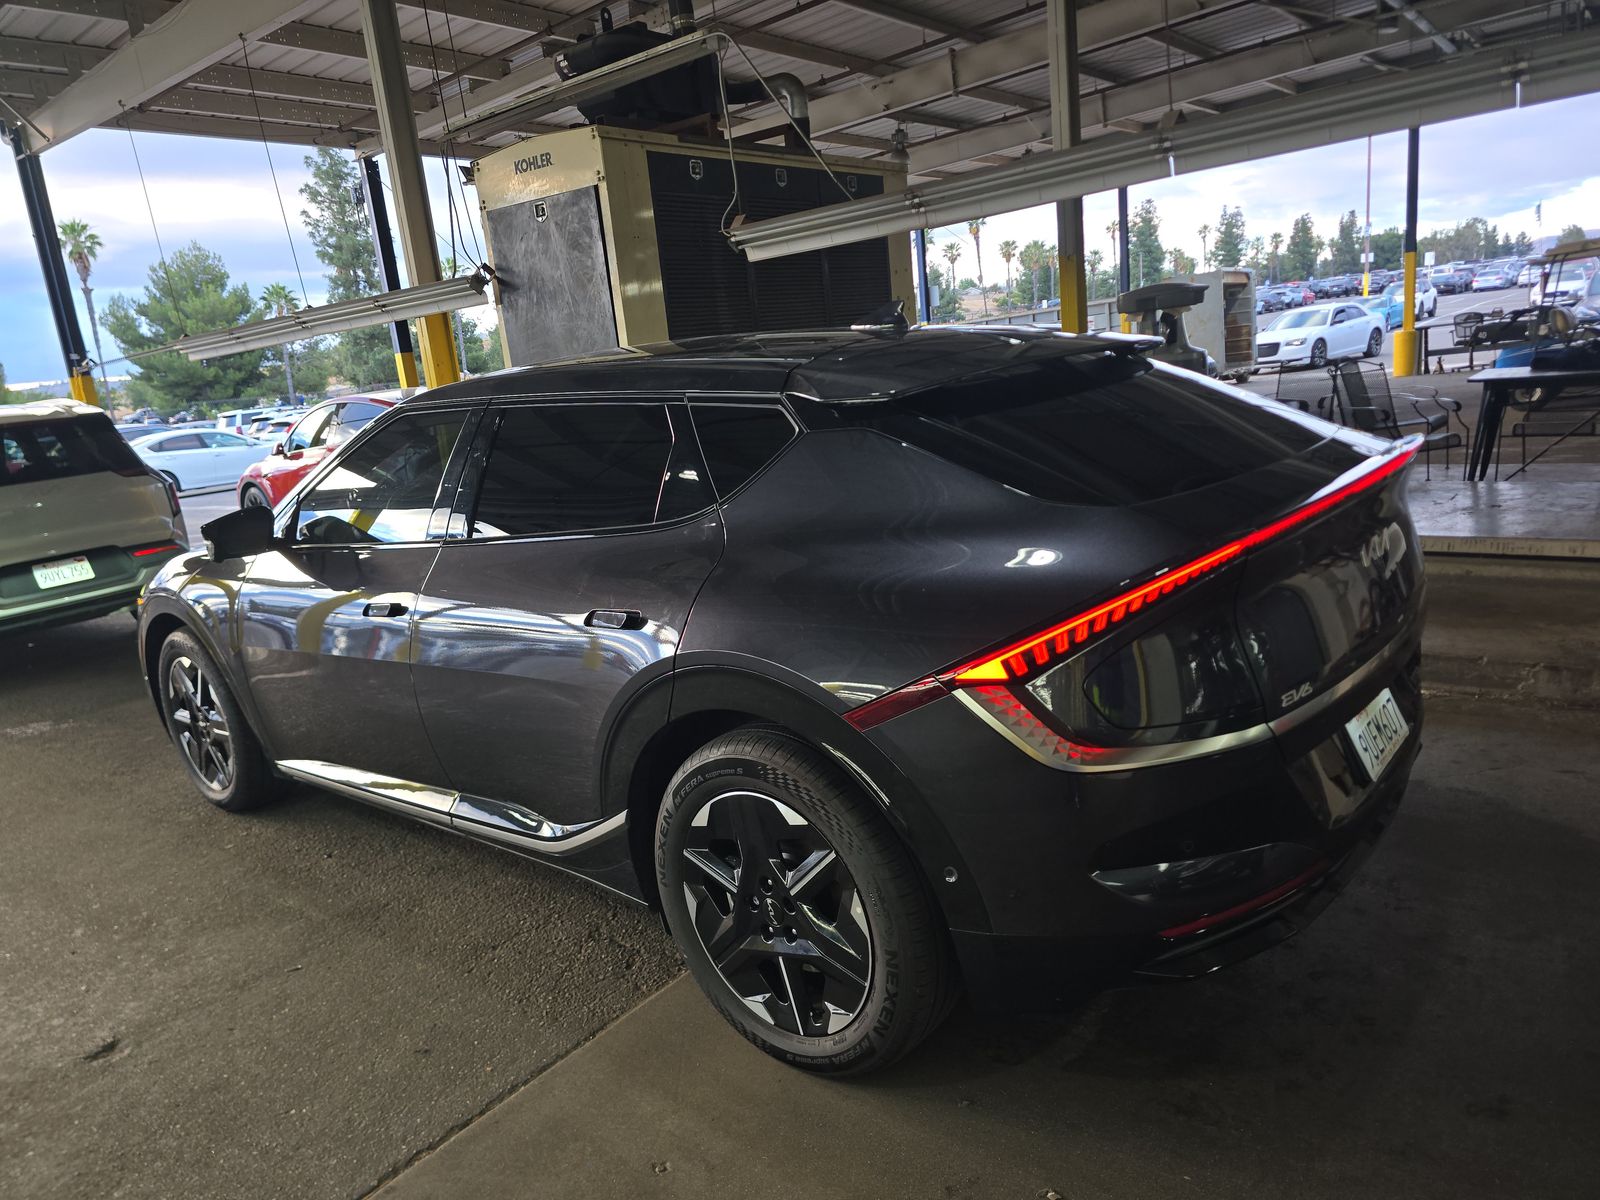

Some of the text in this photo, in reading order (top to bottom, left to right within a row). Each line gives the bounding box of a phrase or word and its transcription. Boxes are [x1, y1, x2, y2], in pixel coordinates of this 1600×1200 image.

[513, 151, 553, 175] KOHLER
[1281, 681, 1313, 707] EV6
[1358, 697, 1403, 769] 9UEM607
[658, 807, 674, 888] NEXEN
[872, 948, 900, 1038] NEXEN
